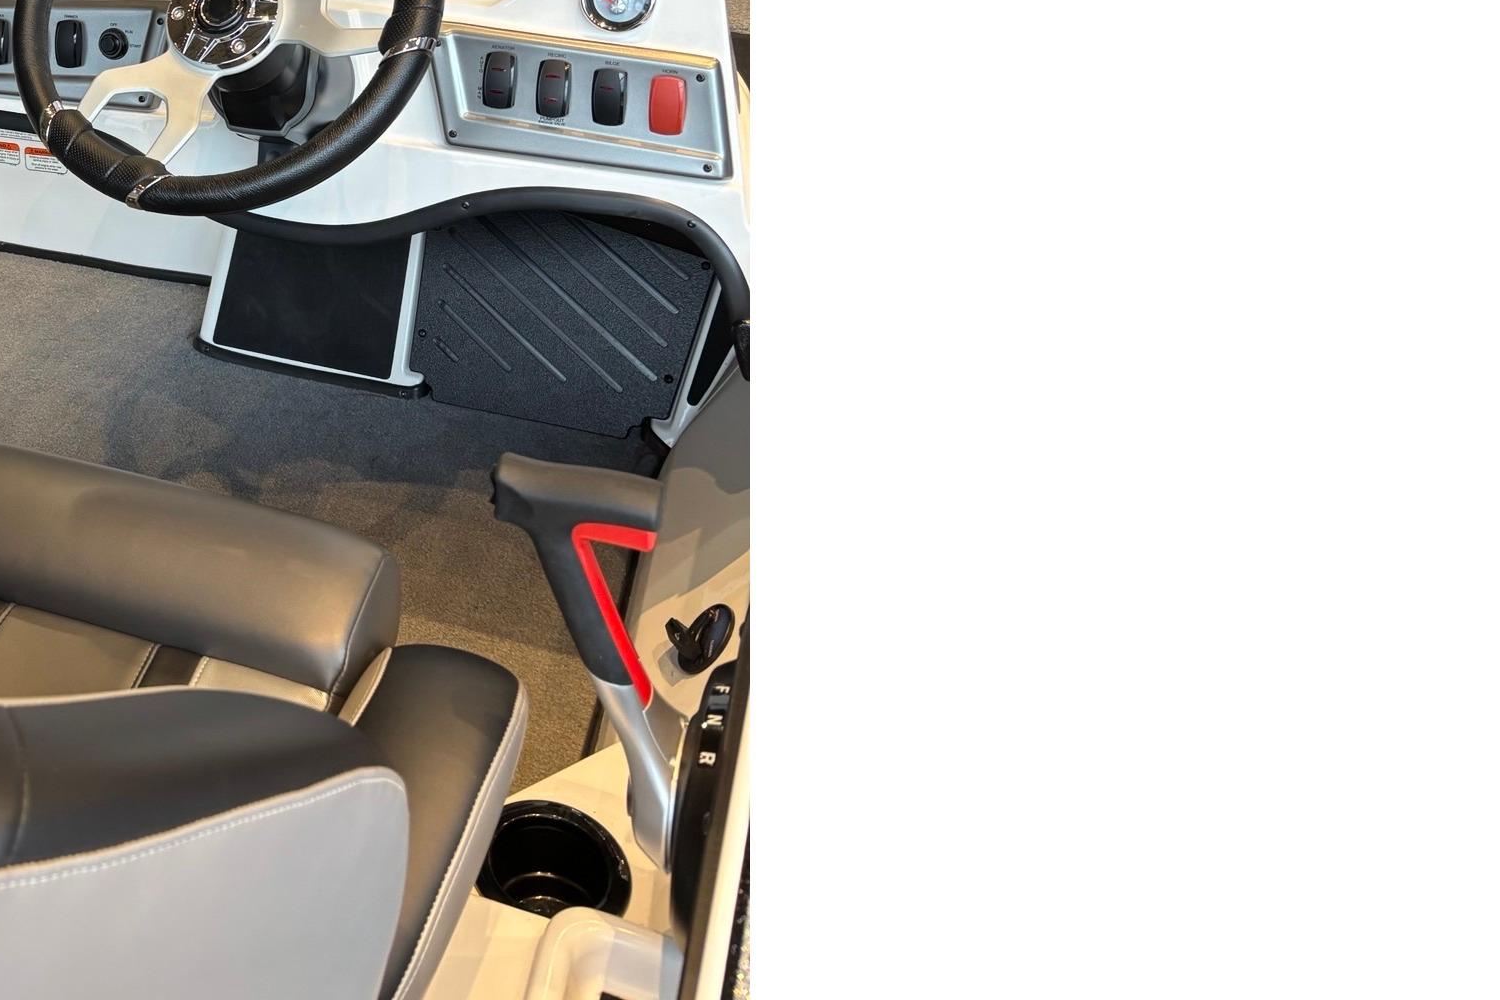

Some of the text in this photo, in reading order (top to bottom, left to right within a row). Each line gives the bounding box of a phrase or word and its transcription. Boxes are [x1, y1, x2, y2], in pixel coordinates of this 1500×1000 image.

[715, 684, 730, 695] F
[707, 714, 724, 726] N
[699, 752, 716, 767] R
